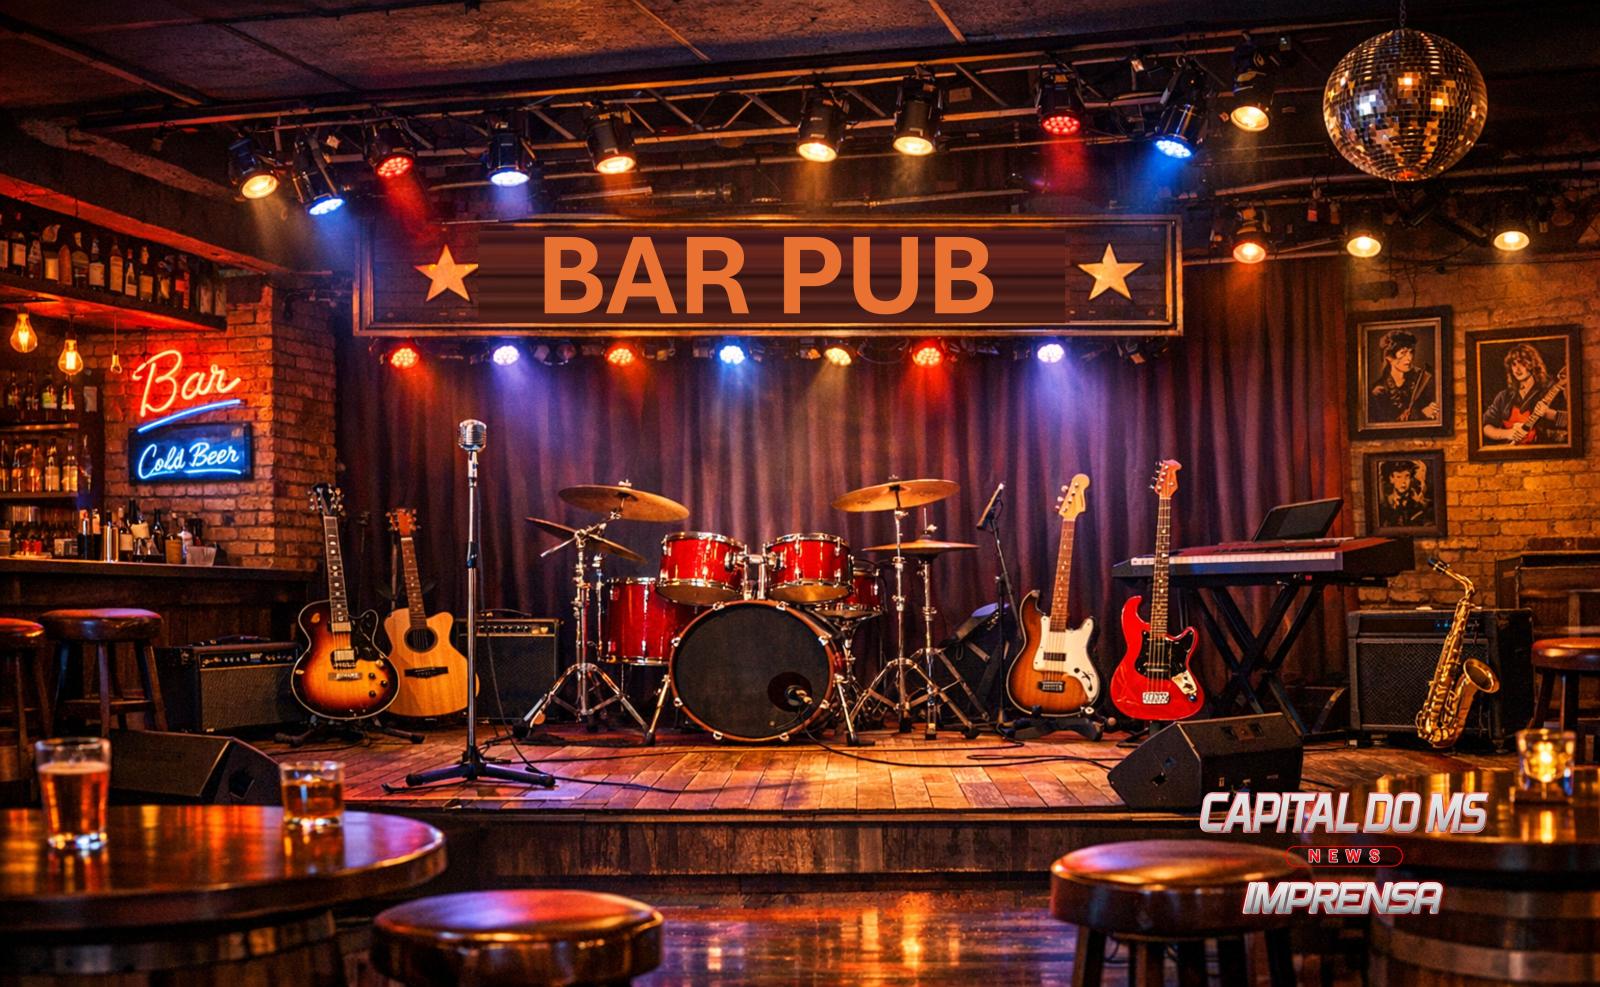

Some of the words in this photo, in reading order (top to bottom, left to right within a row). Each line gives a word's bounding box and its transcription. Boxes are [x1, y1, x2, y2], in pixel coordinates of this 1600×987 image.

[544, 237, 749, 314] BAR
[783, 237, 994, 315] PUB
[133, 351, 241, 417] Bar
[138, 443, 185, 479] Cold
[189, 442, 239, 468] Beer
